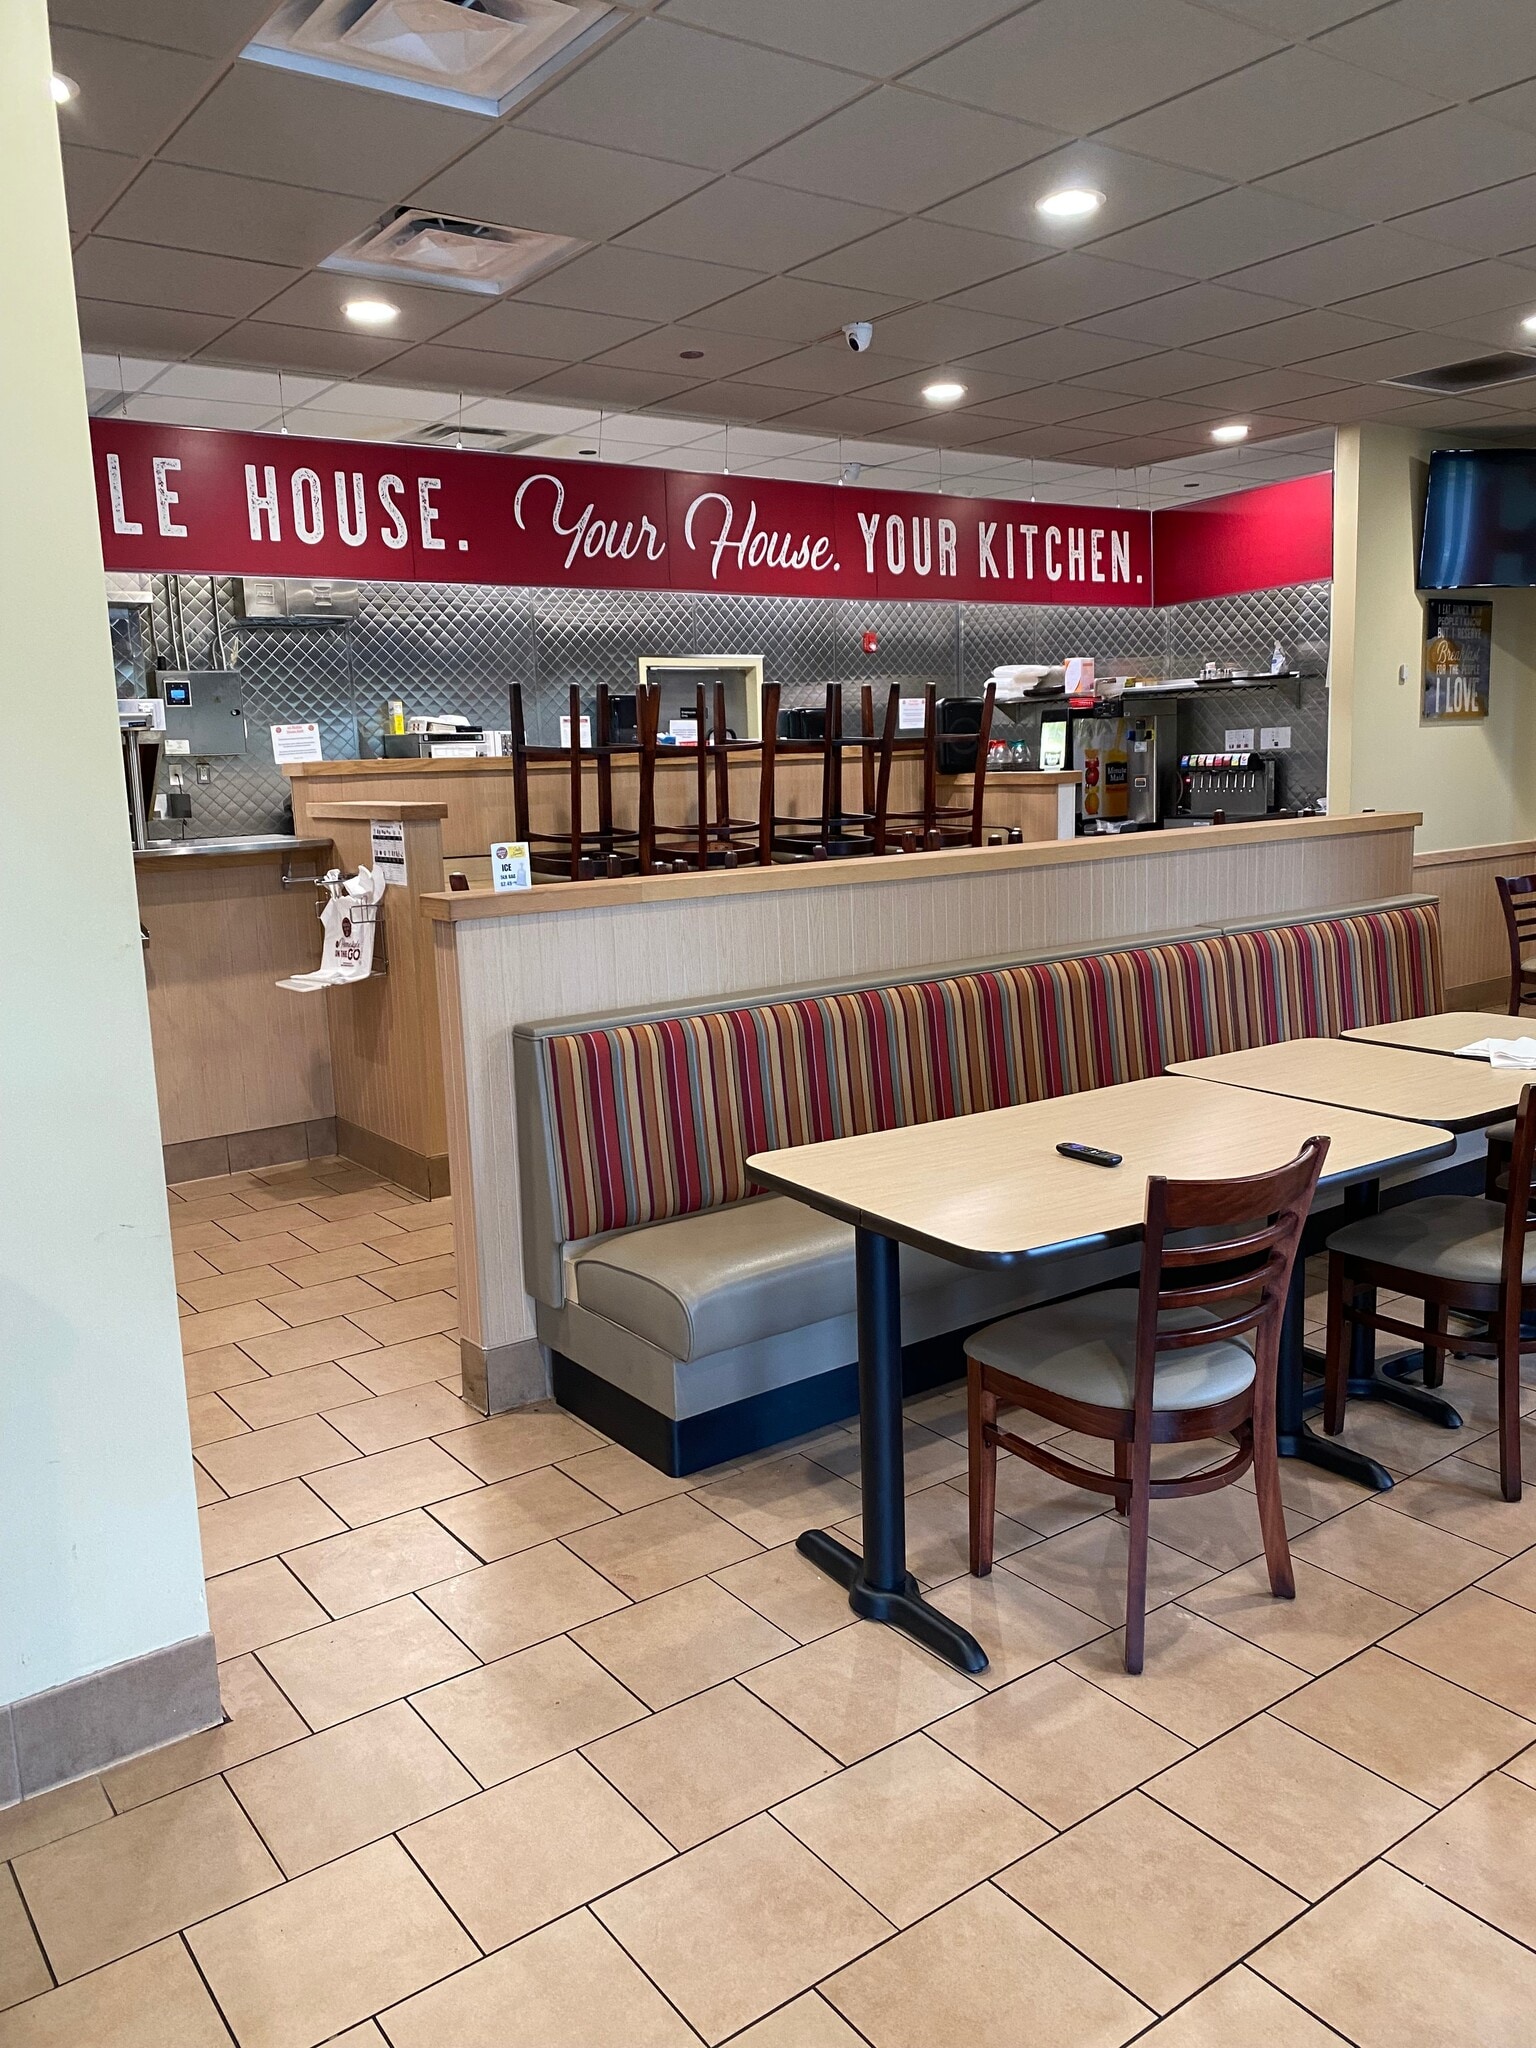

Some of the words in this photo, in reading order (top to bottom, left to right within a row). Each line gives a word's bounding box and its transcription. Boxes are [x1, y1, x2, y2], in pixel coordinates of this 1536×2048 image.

[244, 463, 469, 551] HOUSE.
[513, 473, 666, 569] Your
[685, 492, 841, 580] House.
[857, 512, 957, 576] YOUR
[978, 521, 1143, 584] KITCHEN.
[1442, 604, 1451, 615] EAT
[1453, 604, 1469, 616] DINNER
[1437, 616, 1459, 626] PEOPLE
[1464, 617, 1482, 627] KNOW
[1437, 627, 1449, 639] BUT
[1457, 627, 1482, 639] RESERVE
[1436, 640, 1480, 663] Breakfast
[1436, 664, 1446, 675] FOR
[1449, 664, 1459, 675] THE
[1461, 664, 1480, 675] PEOPLE
[1435, 677, 1441, 713] I
[1445, 677, 1480, 713] LOVE
[1107, 766, 1127, 775] Minute
[1109, 773, 1125, 782] Maid
[501, 863, 512, 872] ICE
[348, 948, 361, 961] GO
